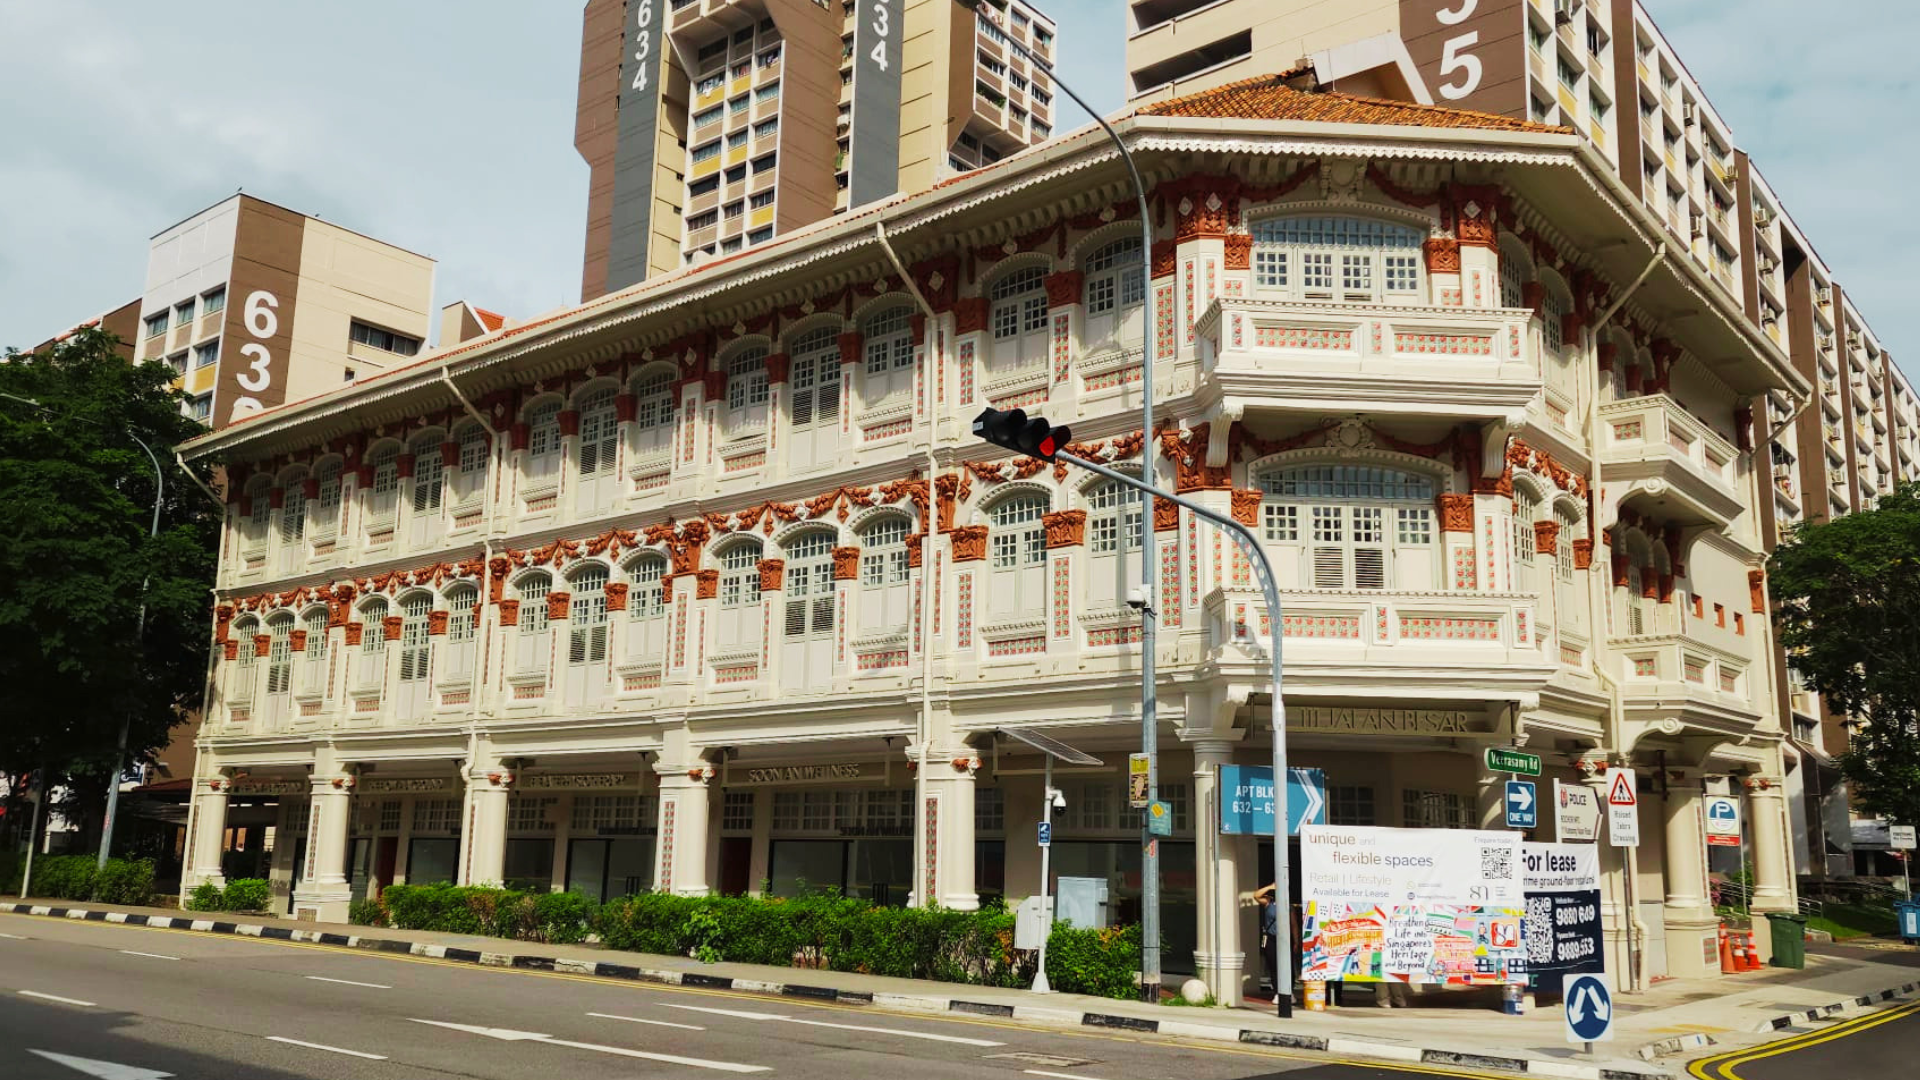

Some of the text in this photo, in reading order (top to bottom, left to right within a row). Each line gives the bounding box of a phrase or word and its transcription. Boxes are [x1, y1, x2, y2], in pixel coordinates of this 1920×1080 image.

[871, 0, 889, 72] 34
[632, 0, 652, 92] 634
[1491, 751, 1538, 771] Veerasamy Rd
[1236, 785, 1254, 797] APT
[1569, 793, 1587, 806] POLICE
[1232, 801, 1251, 813] 632
[1509, 812, 1534, 823] ONE WAY
[1309, 832, 1356, 847] unique
[1333, 851, 1434, 869] flexible spaces
[1545, 850, 1577, 872] lease
[1309, 872, 1339, 884] Retail
[1349, 873, 1392, 887] Lifestyle
[1313, 887, 1390, 898] Available for Lease
[1395, 928, 1411, 938] Life
[1391, 949, 1428, 961] Heritage
[1397, 960, 1425, 972] Beyond
